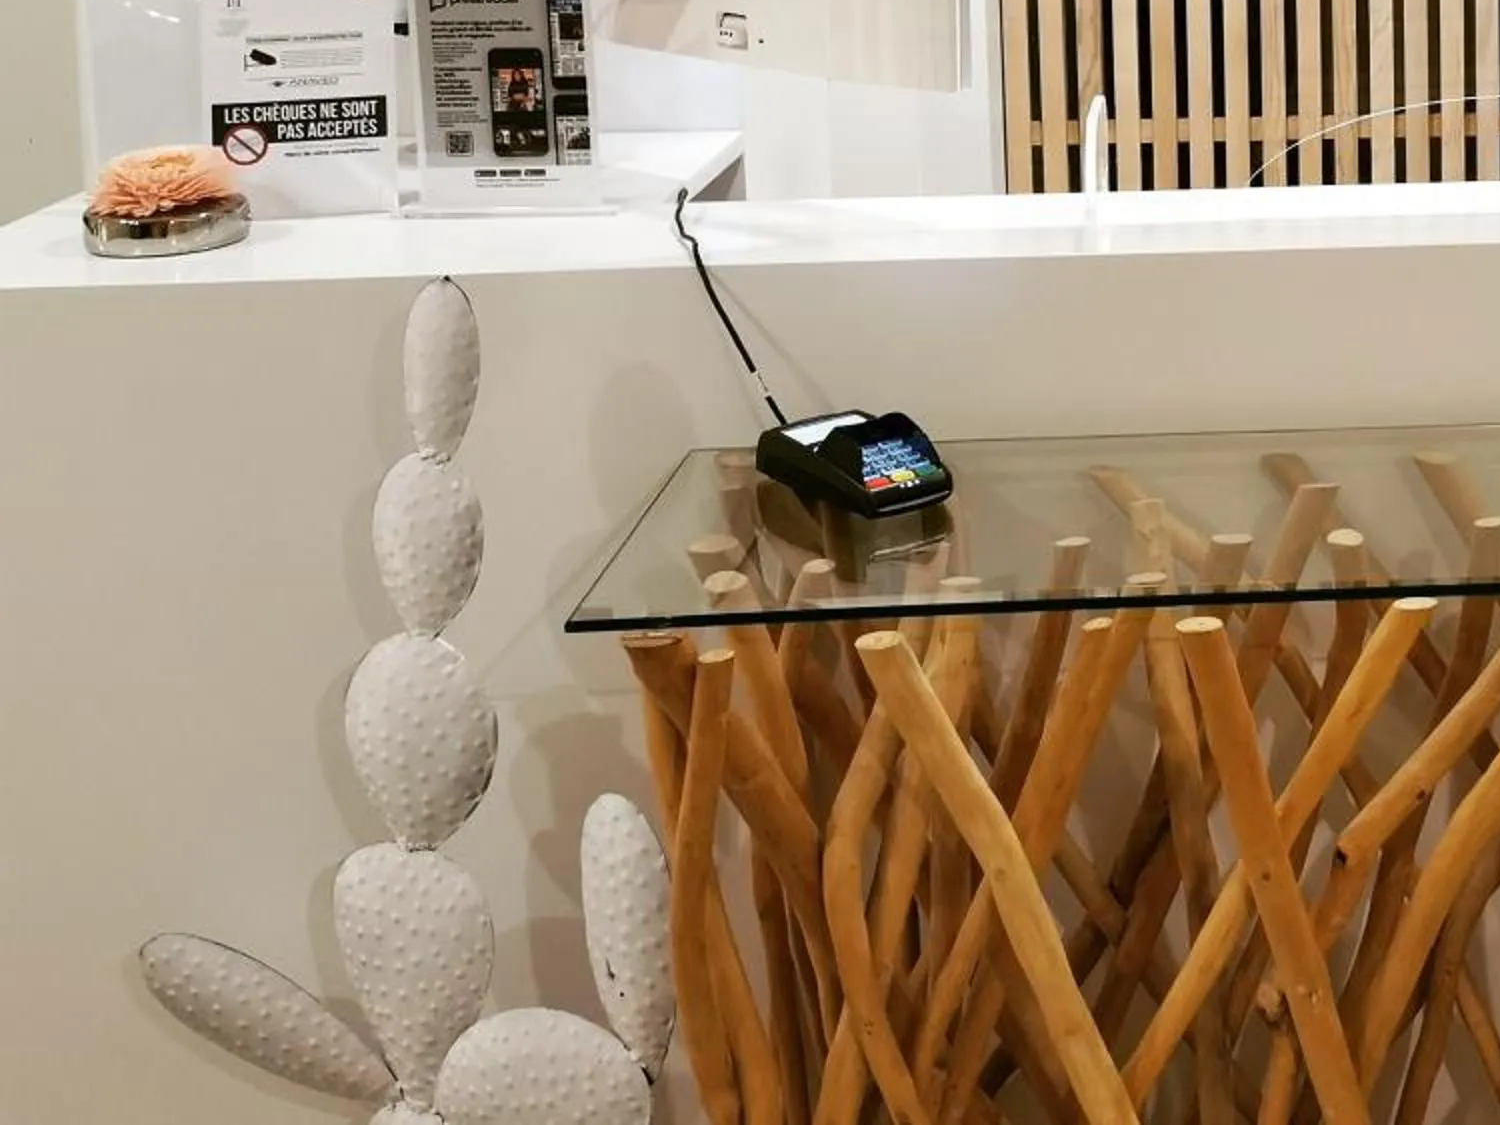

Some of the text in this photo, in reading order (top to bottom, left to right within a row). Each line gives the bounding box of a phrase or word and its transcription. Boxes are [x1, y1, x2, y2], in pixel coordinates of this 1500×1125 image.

[224, 100, 379, 124] LES CHÈQUES NE SONT
[277, 117, 379, 140] PAS ACCEPTÉS
